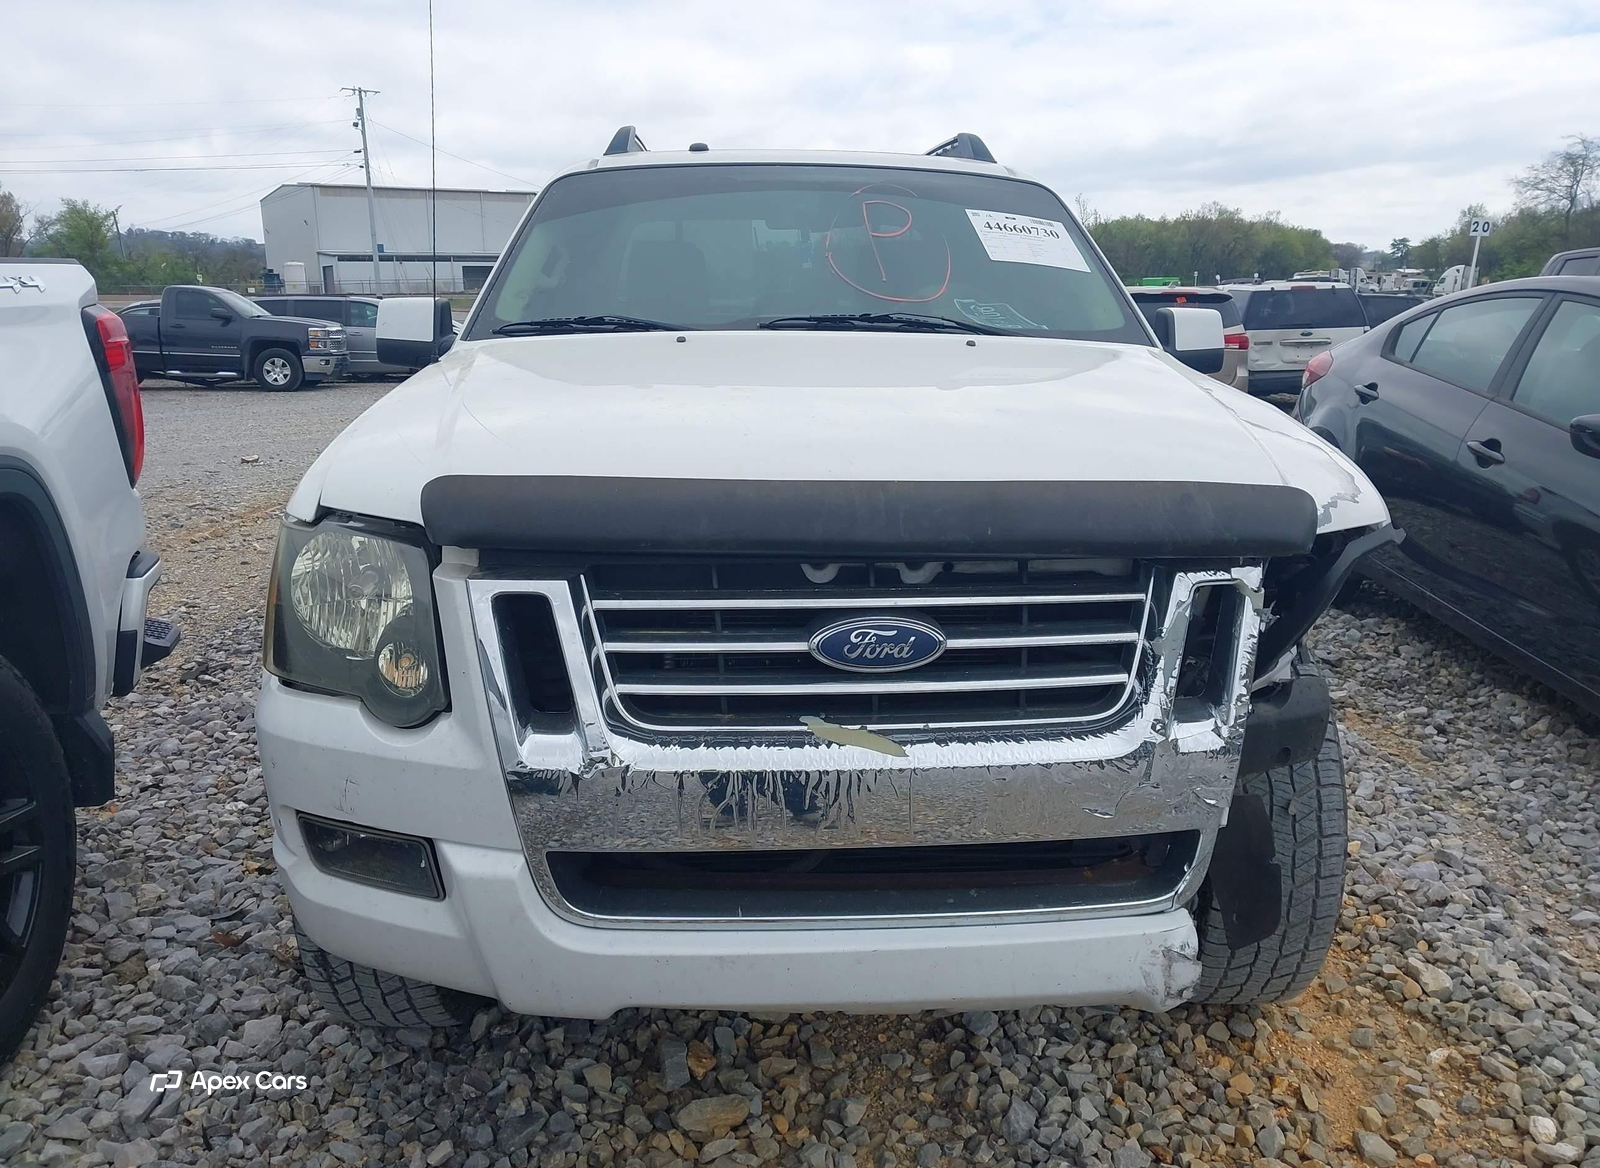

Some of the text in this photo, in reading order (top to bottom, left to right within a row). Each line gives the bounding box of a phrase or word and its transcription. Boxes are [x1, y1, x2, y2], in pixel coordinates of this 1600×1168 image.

[983, 220, 1060, 240] 44660730
[1471, 220, 1490, 233] 20
[862, 200, 912, 281] P
[844, 629, 917, 659] Ford
